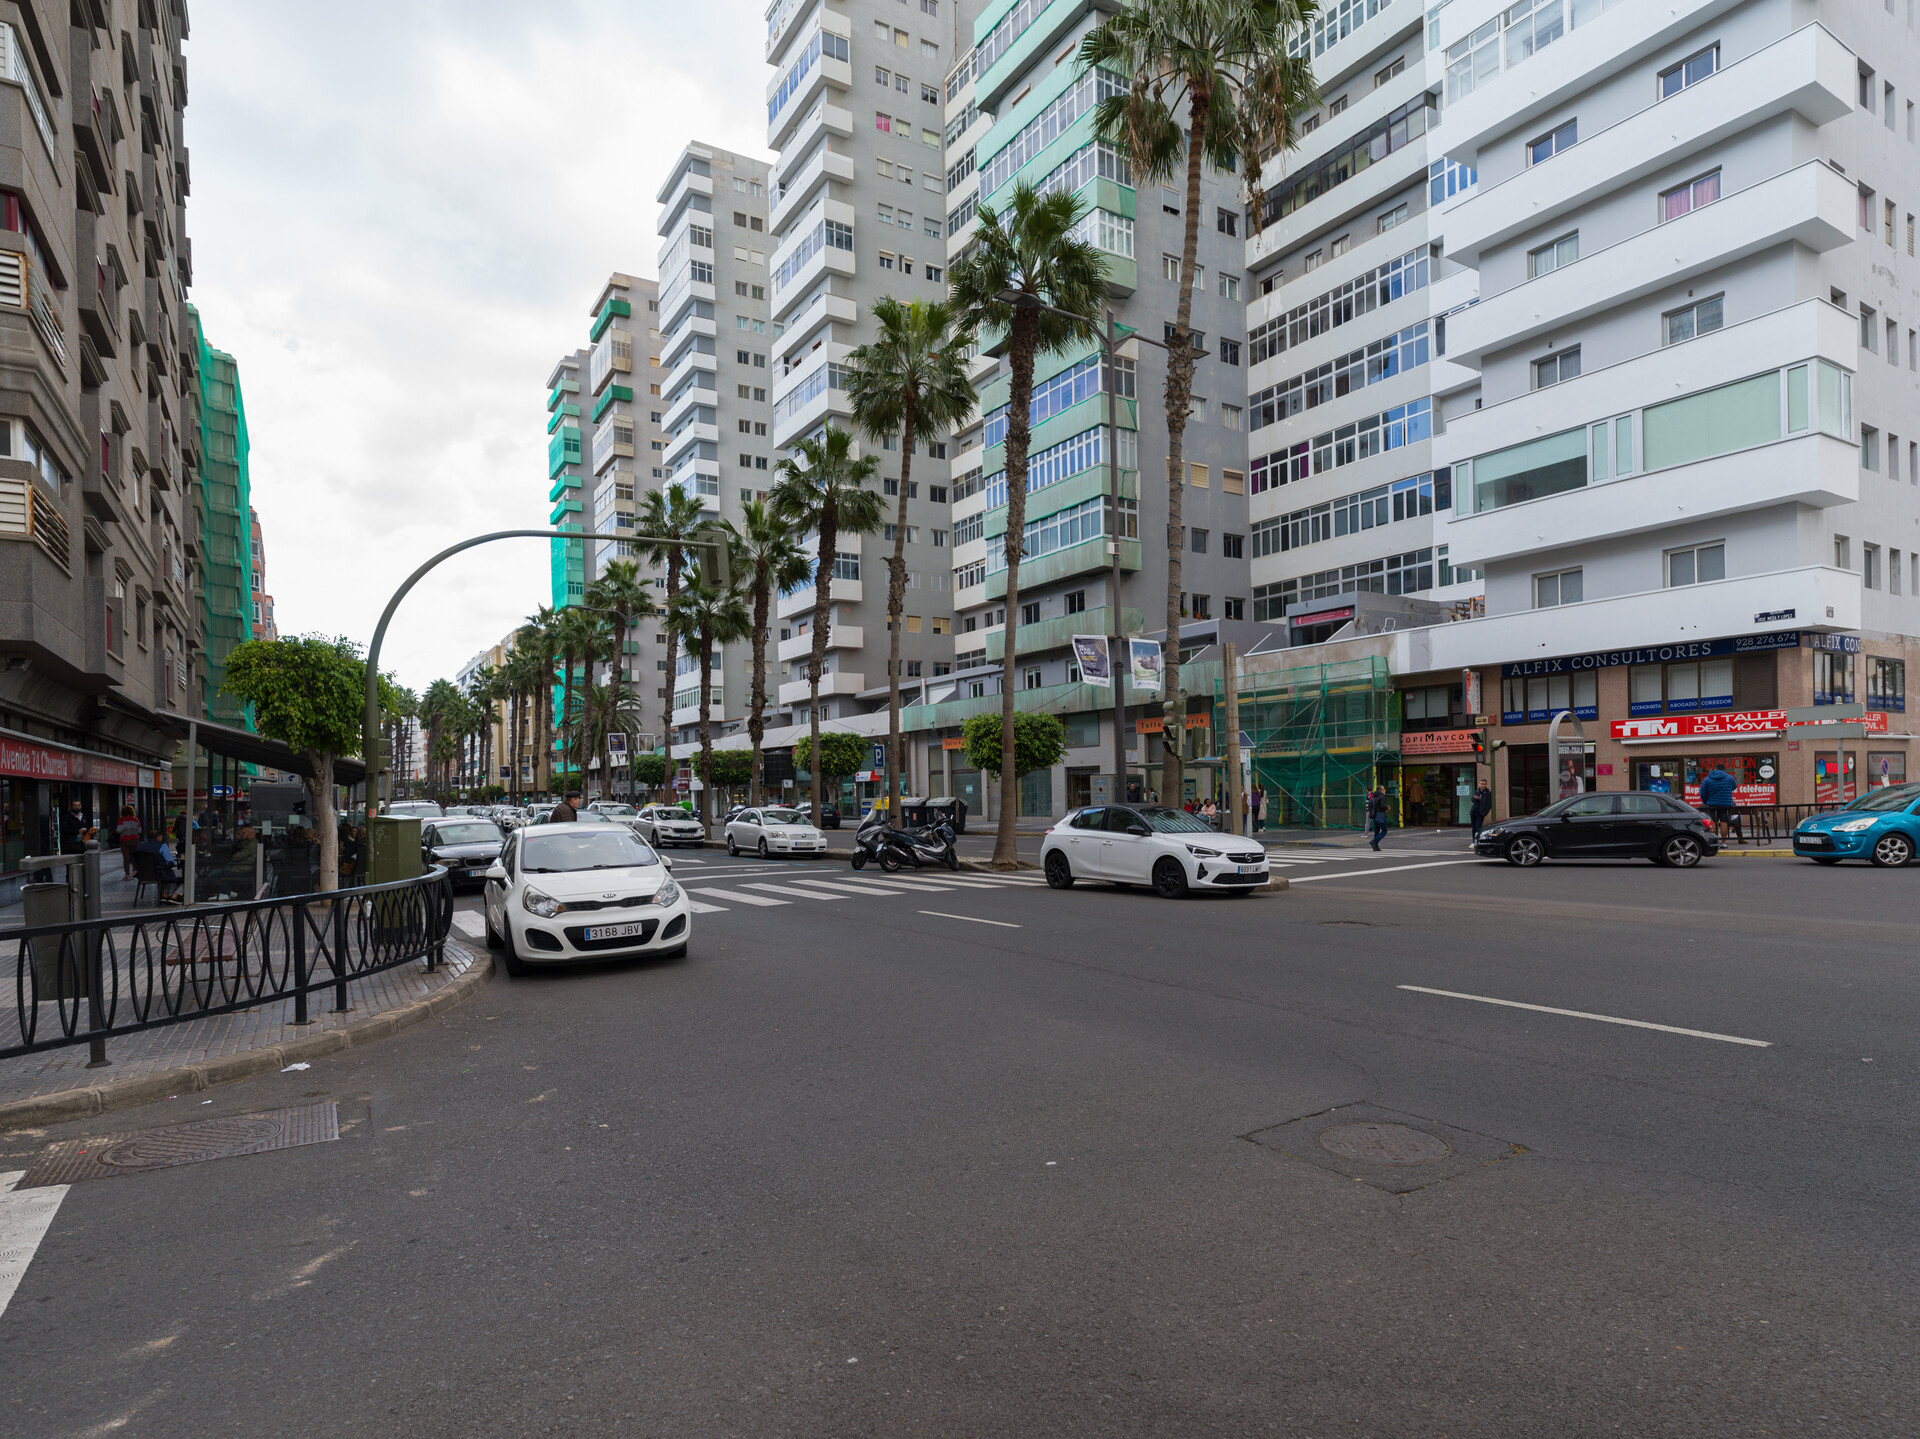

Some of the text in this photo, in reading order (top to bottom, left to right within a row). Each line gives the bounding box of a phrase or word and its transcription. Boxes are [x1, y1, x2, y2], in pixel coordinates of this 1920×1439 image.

[1736, 633, 1796, 647] 928 276 674
[1814, 634, 1840, 649] ALFIX
[1511, 642, 1712, 675] ALFIX CONSULTORES
[1, 743, 68, 776] Avenida 74 Churrería
[1744, 771, 1756, 783] 2H
[592, 924, 640, 938] 3168 JBV
